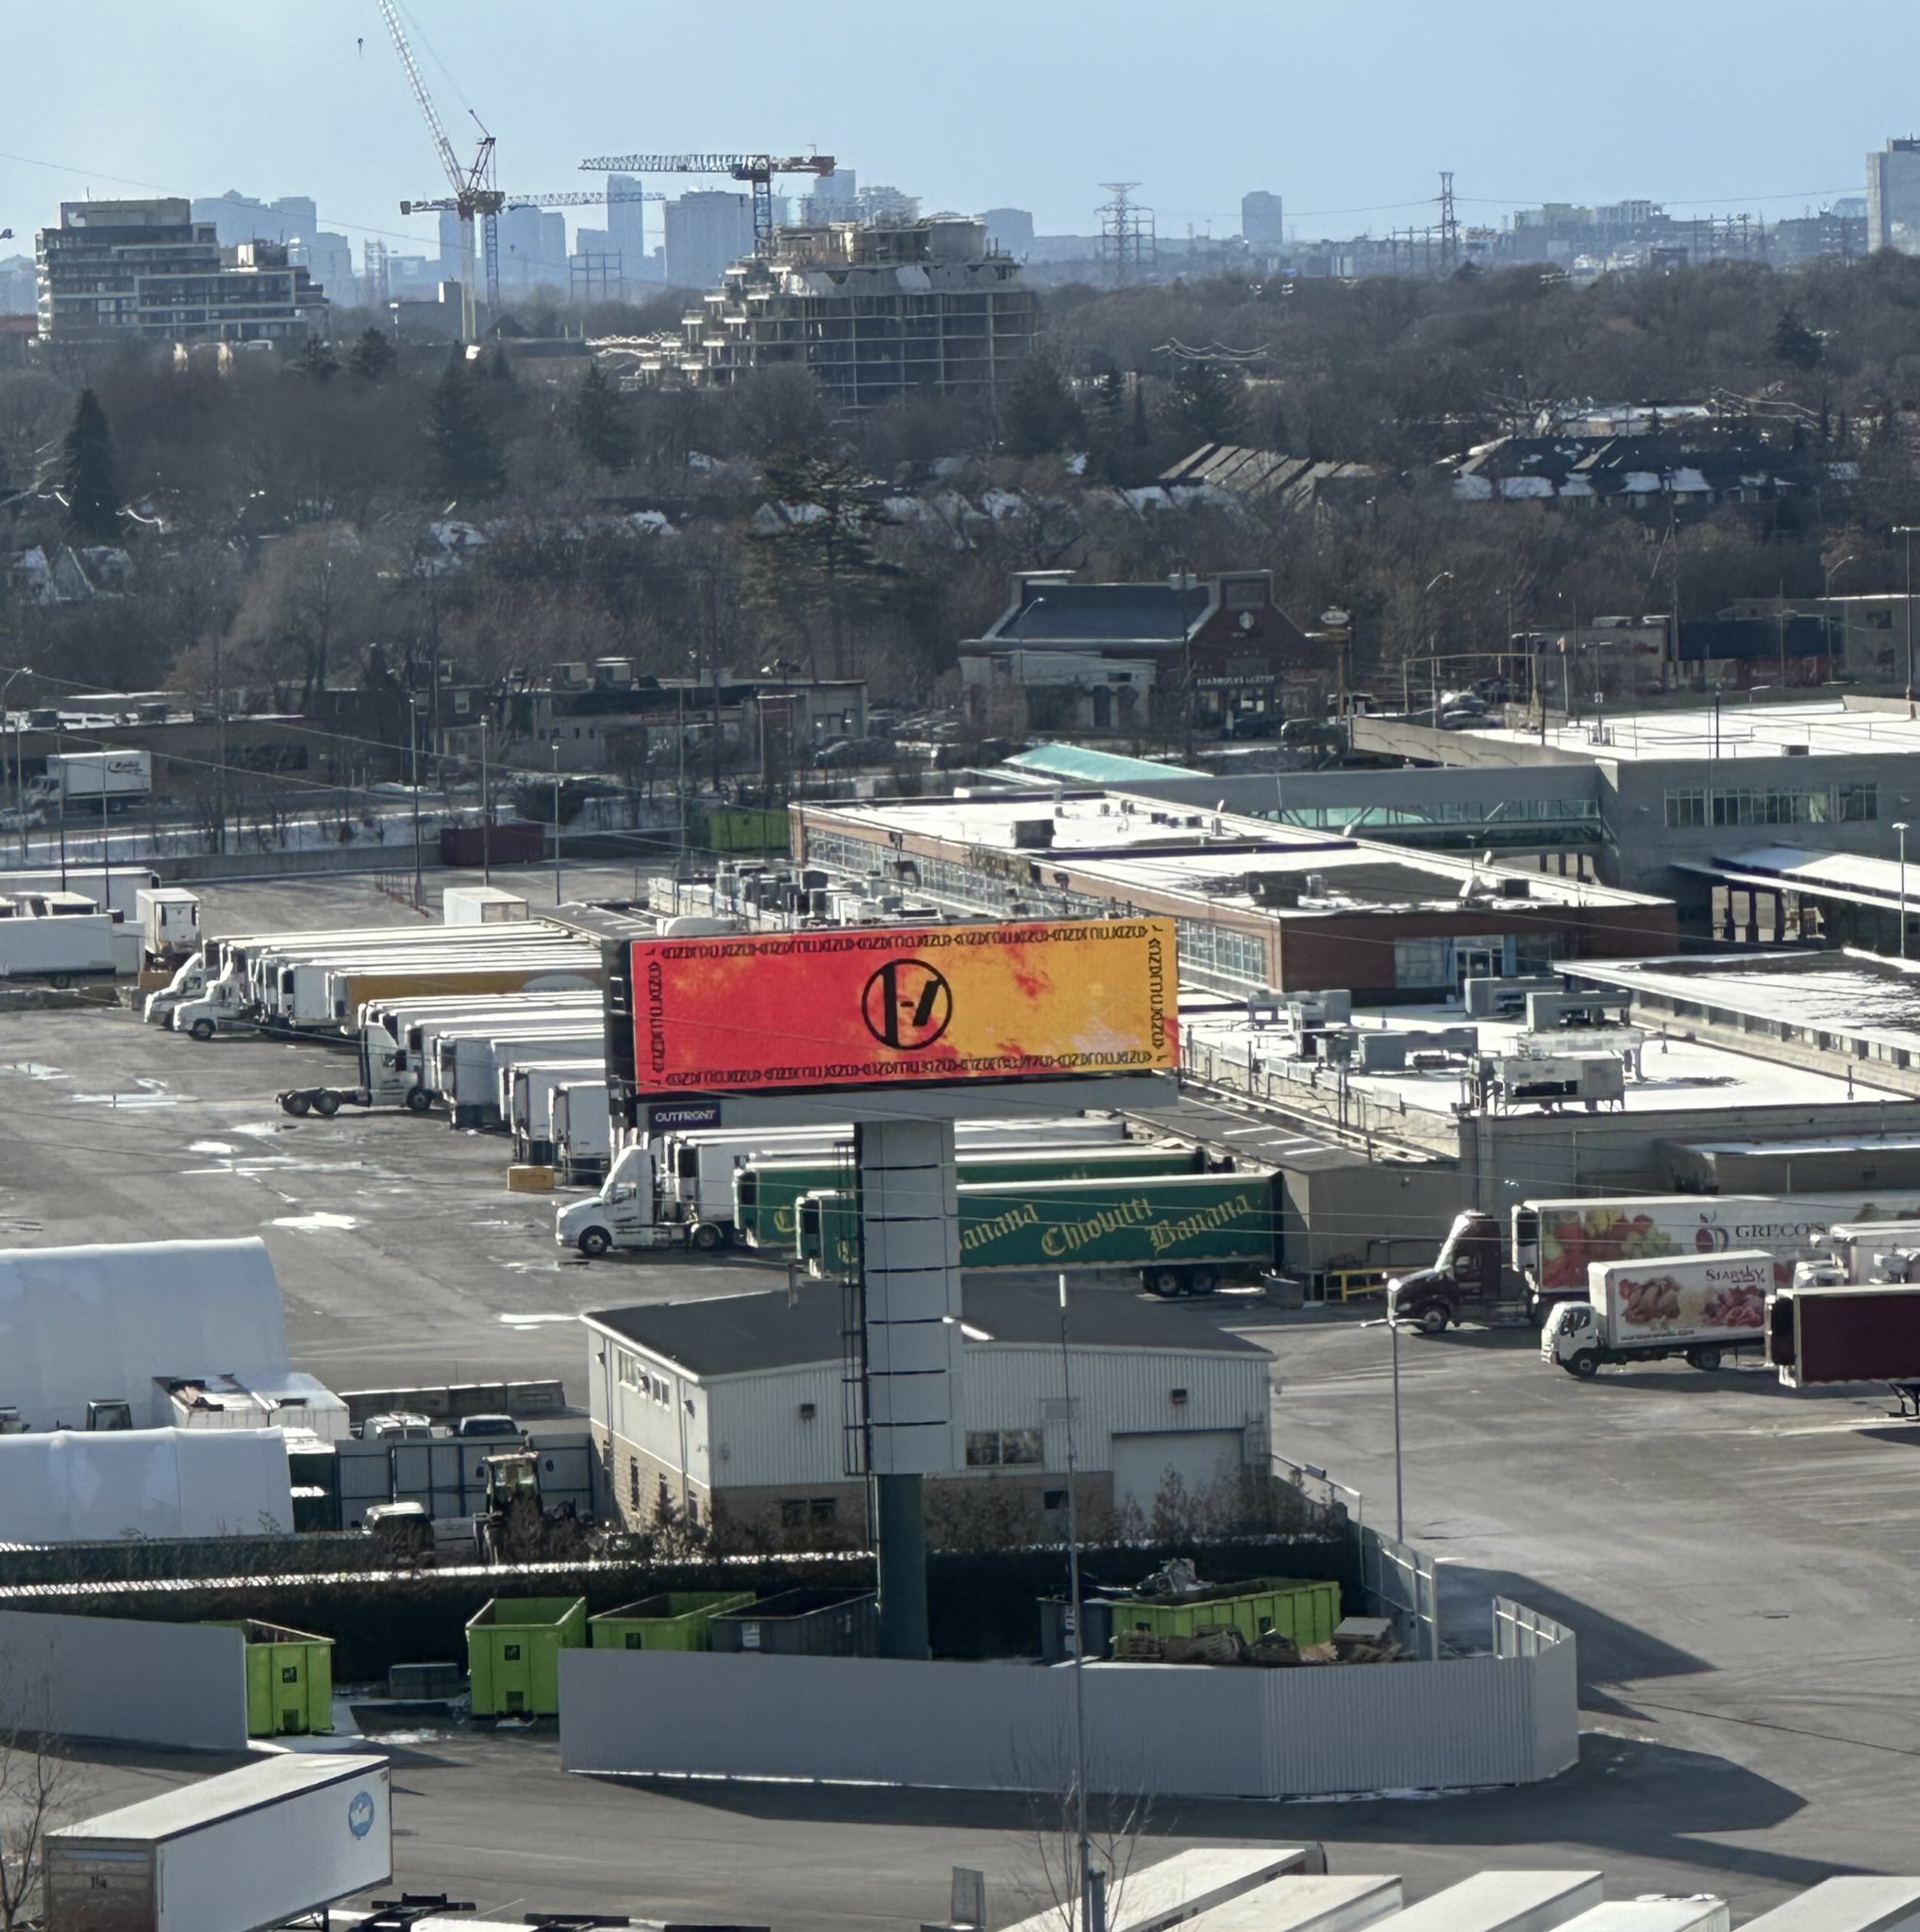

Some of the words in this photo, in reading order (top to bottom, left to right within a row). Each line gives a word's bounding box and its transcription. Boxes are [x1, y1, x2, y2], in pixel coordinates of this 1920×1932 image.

[655, 1109, 716, 1123] OUTFRONT
[959, 1203, 1039, 1250] anana
[1148, 1194, 1253, 1257] Banana
